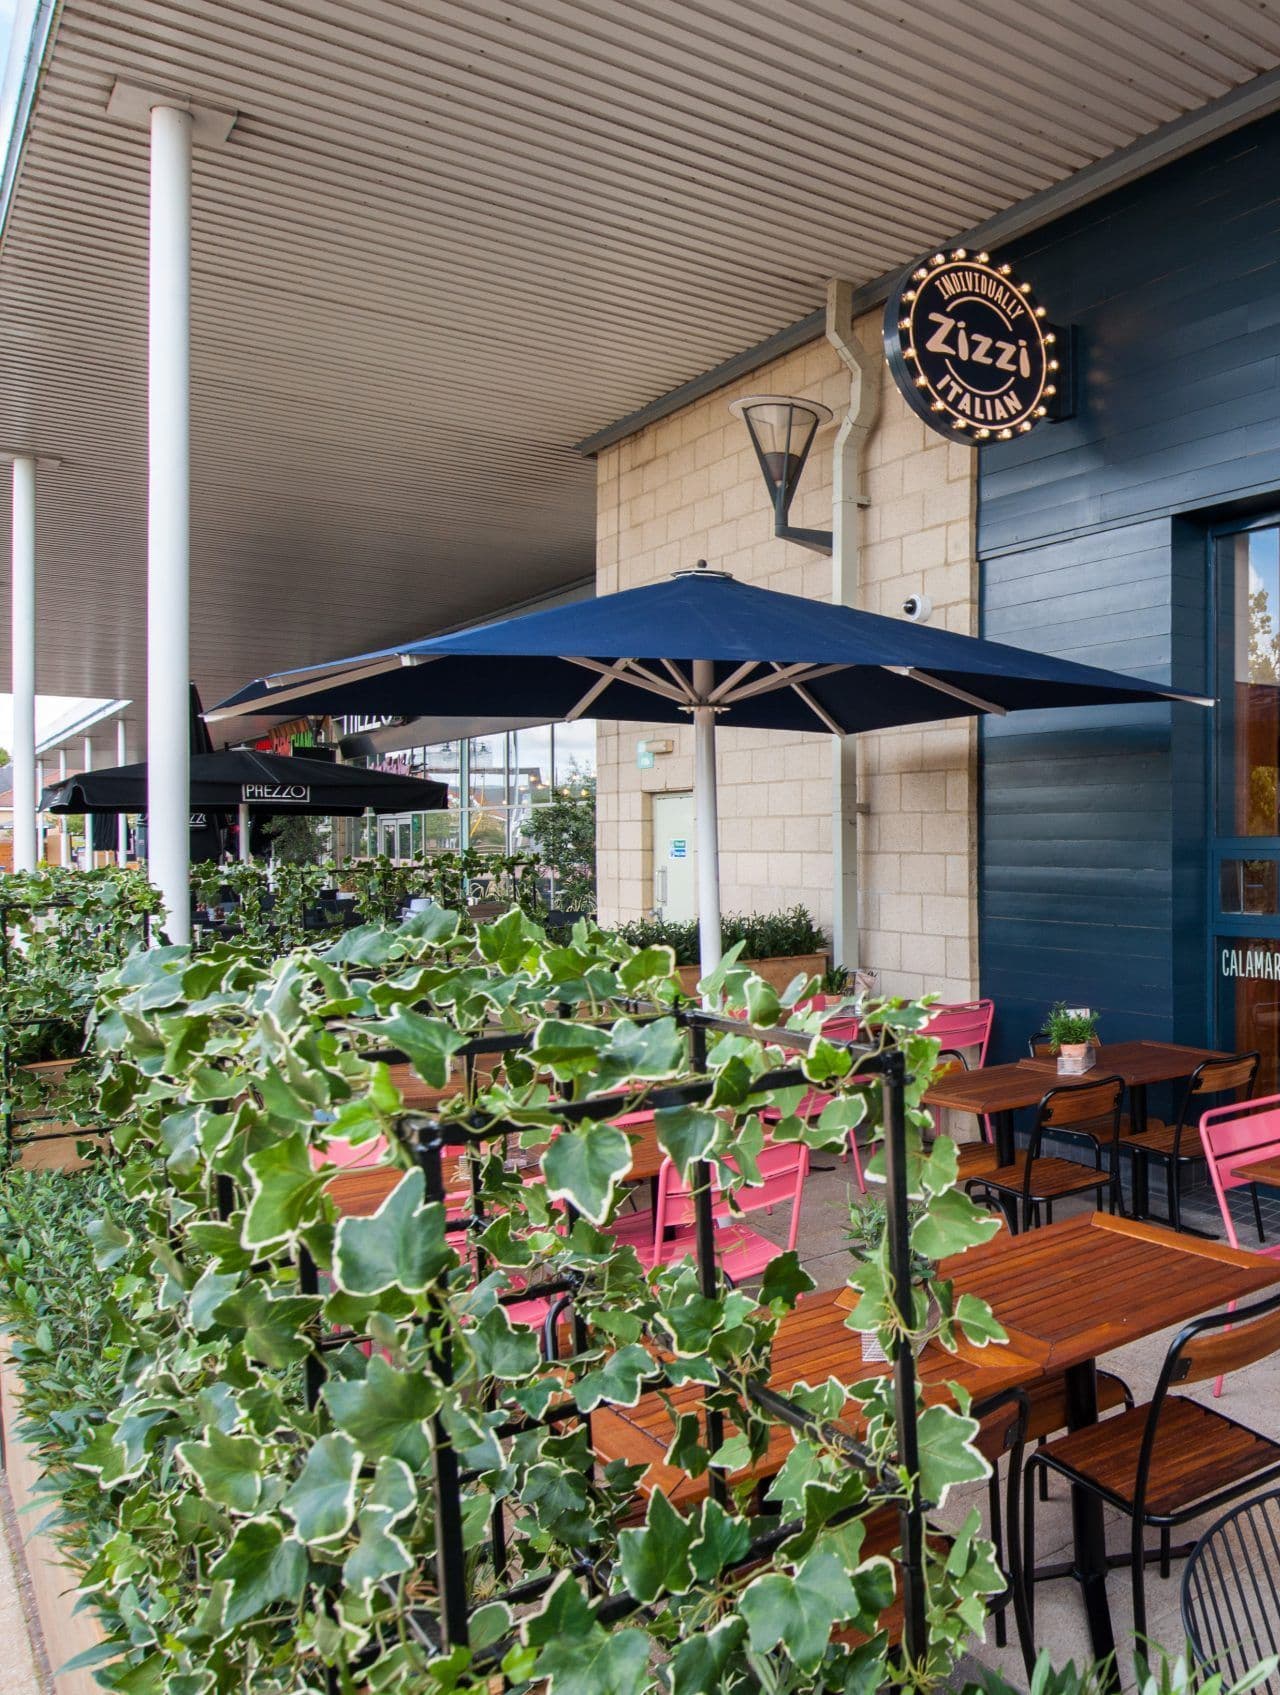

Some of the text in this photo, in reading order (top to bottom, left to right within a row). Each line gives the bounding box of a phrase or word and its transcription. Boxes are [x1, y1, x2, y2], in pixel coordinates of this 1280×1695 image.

[934, 271, 1025, 320] INDIVIDUALLY
[925, 312, 1031, 378] Zizzi
[936, 374, 1022, 420] ITALIAN
[246, 784, 306, 798] PREZZO
